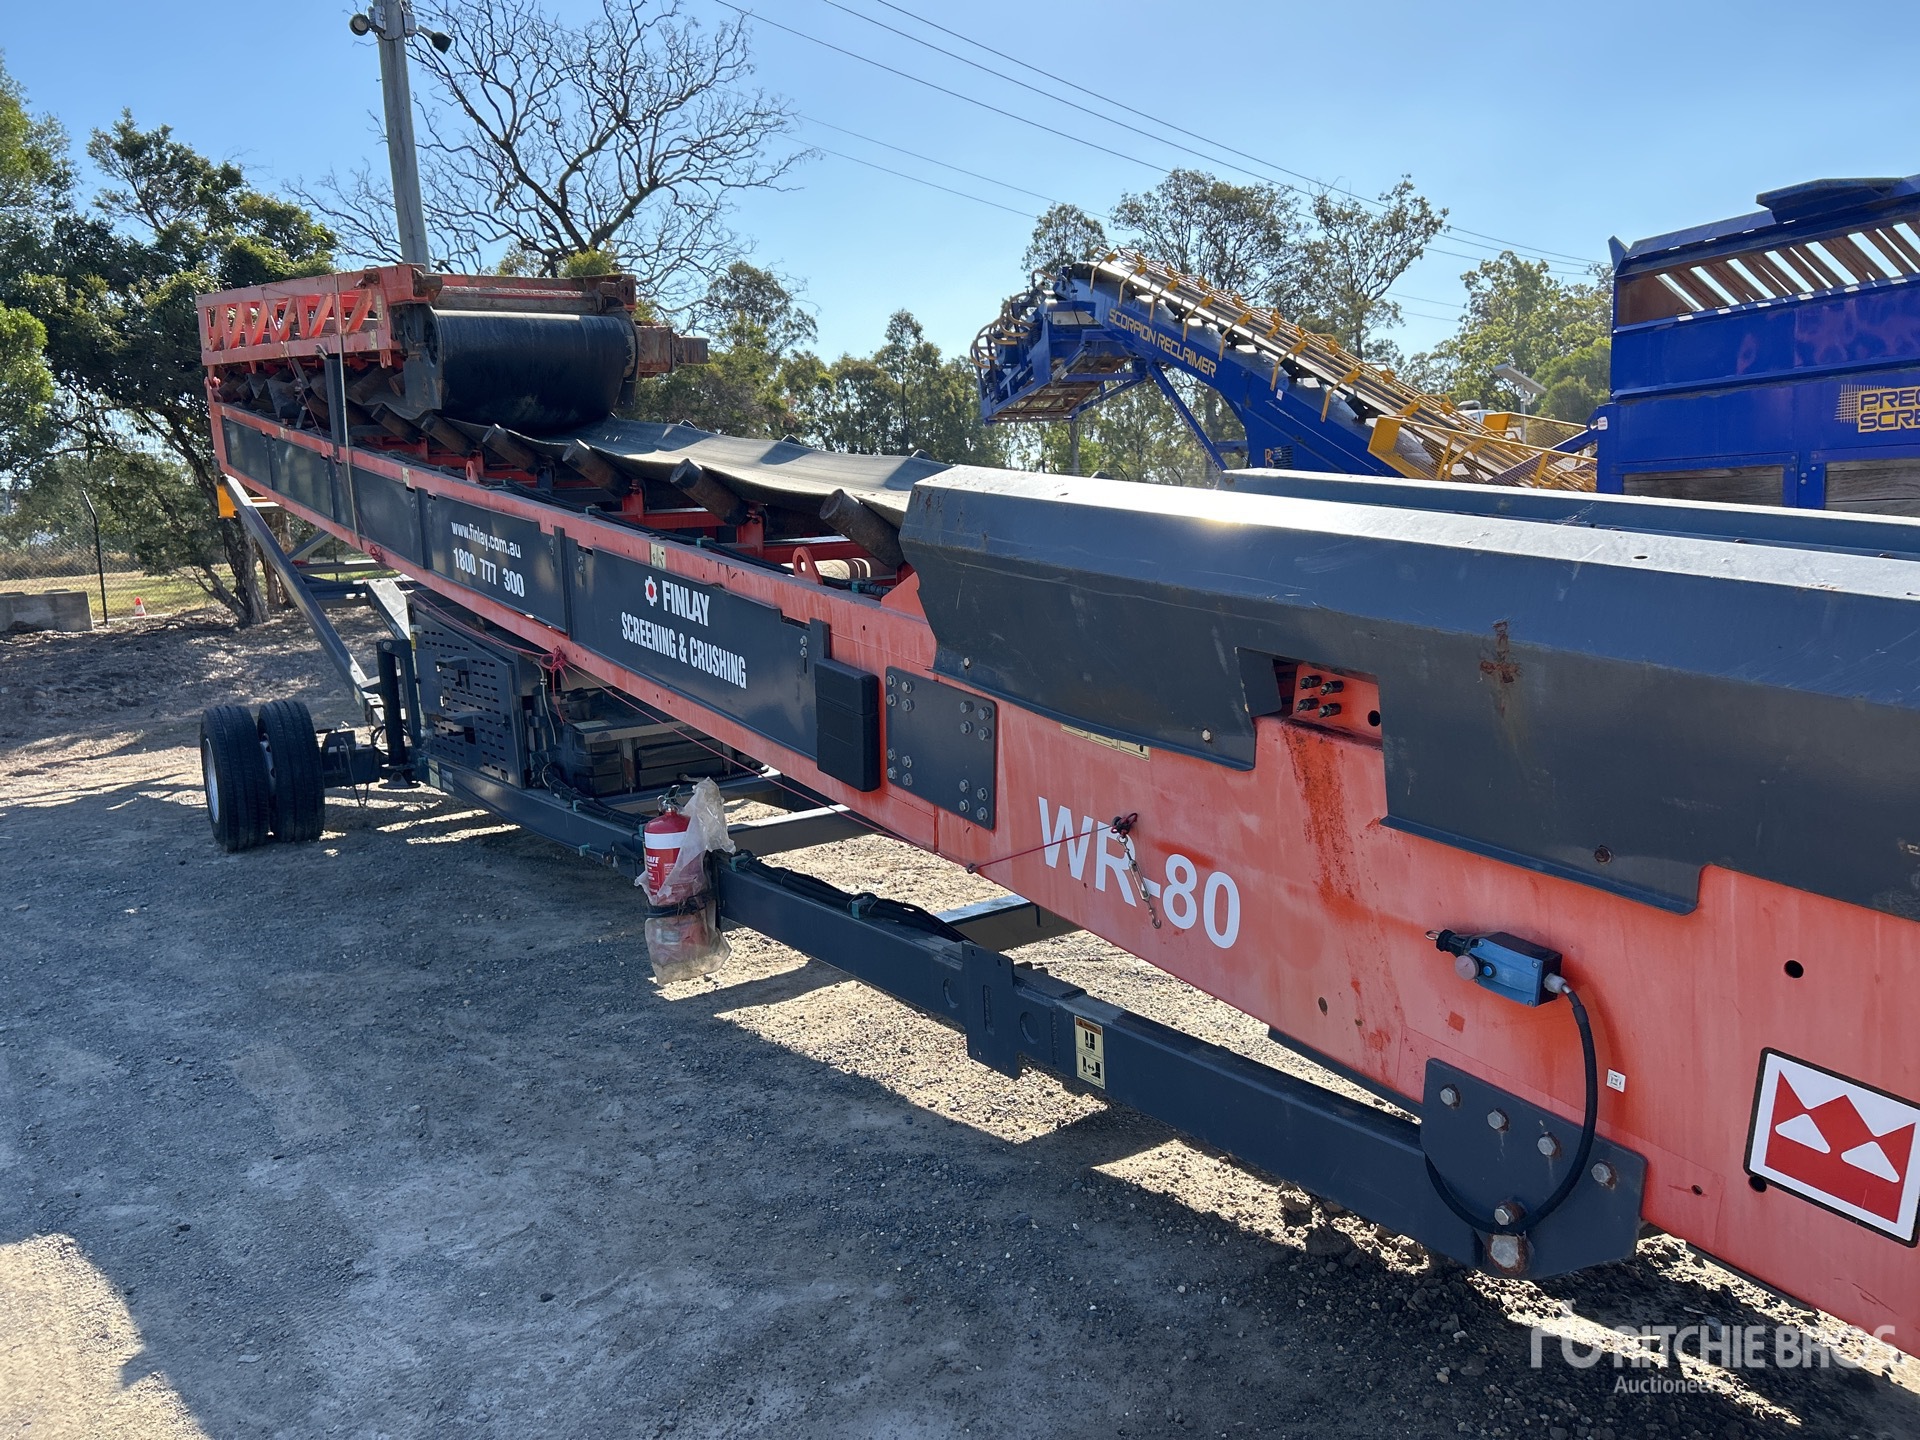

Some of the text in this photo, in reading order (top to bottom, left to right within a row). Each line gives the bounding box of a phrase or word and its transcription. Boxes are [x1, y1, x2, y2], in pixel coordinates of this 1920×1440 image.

[1109, 308, 1217, 379] SCORPION RECLAIMER
[1860, 389, 1920, 411] PRE
[450, 521, 522, 559] www.finlay.com.au
[453, 547, 525, 598] 1800 777 300
[661, 579, 710, 627] FINLAY
[621, 611, 747, 690] SCREENING & CRUSHING
[1037, 796, 1241, 949] WR-80
